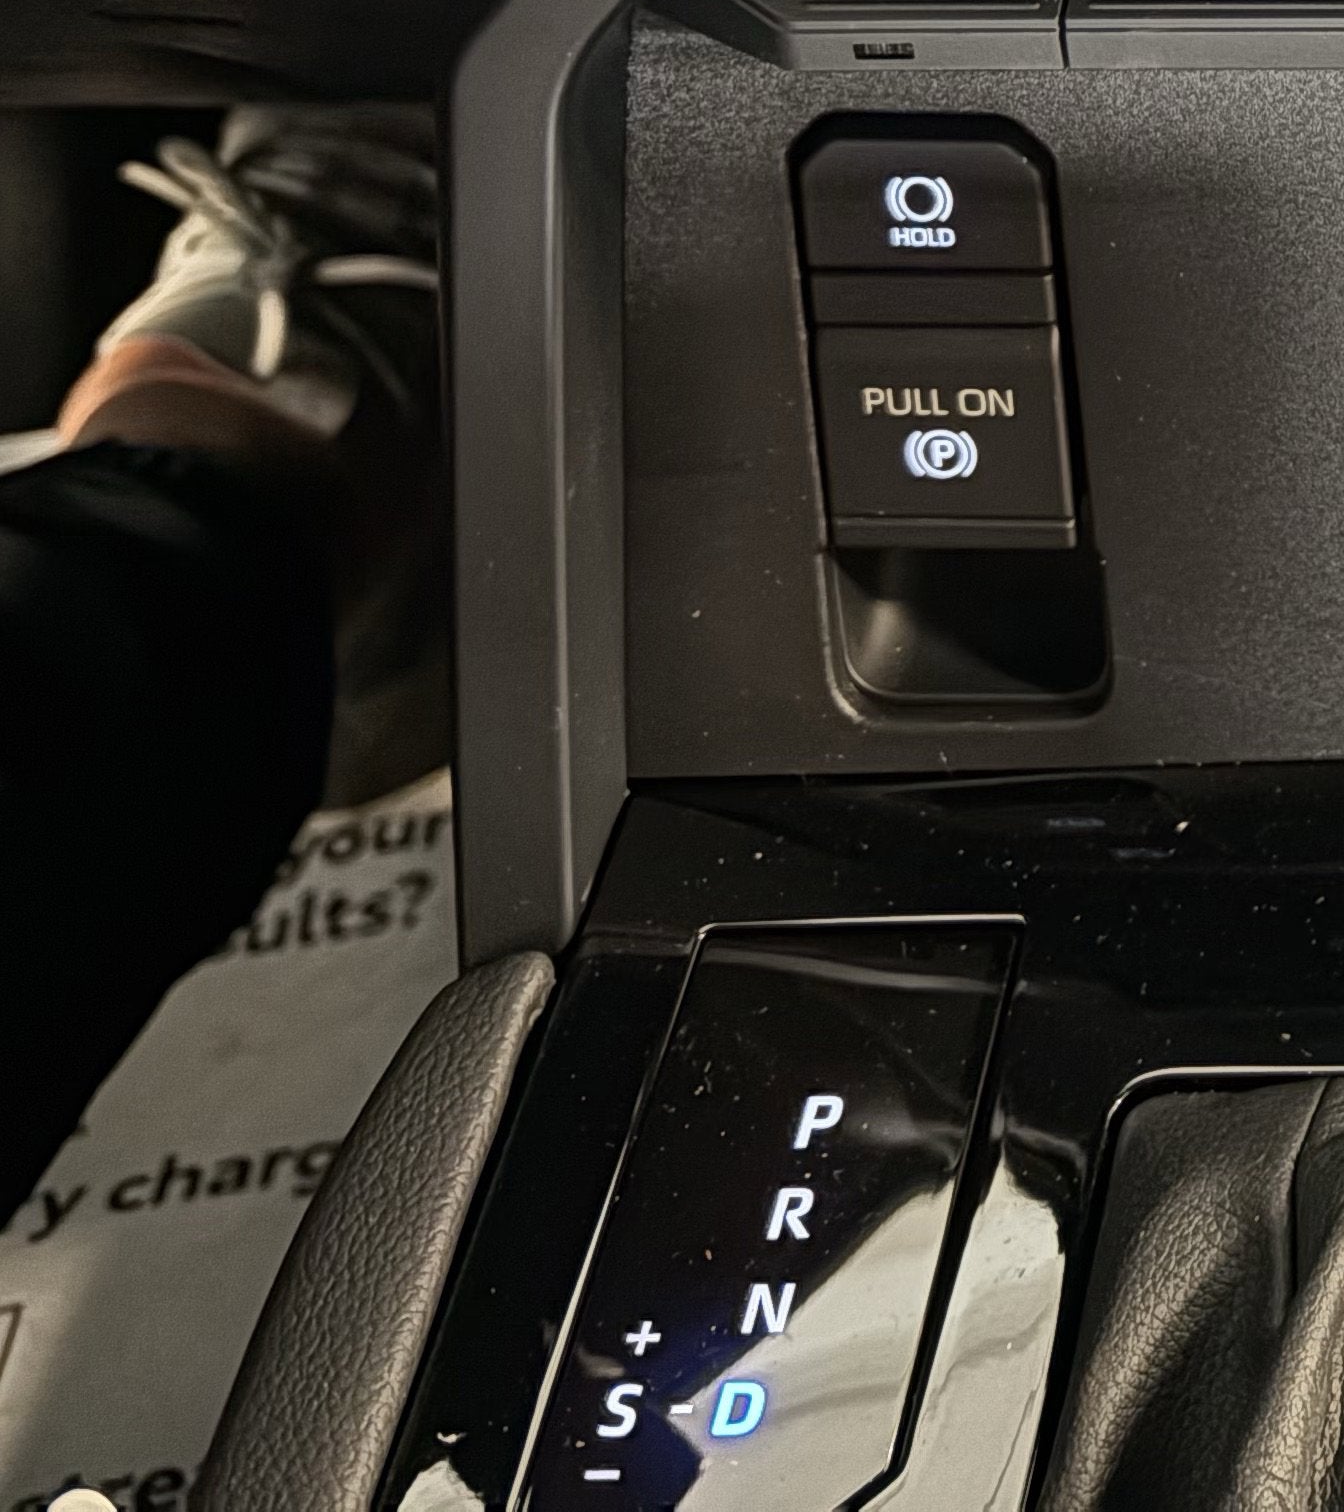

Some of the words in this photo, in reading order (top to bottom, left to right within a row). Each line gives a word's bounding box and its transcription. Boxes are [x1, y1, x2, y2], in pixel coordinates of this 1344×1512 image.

[889, 227, 956, 248] HOLD
[862, 387, 949, 416] PULL
[958, 388, 1015, 417] ON
[244, 868, 433, 952] ults?
[793, 1094, 844, 1150] P
[766, 1187, 815, 1241] R
[740, 1282, 797, 1335] N
[596, 1384, 644, 1438] S
[711, 1382, 766, 1437] D
